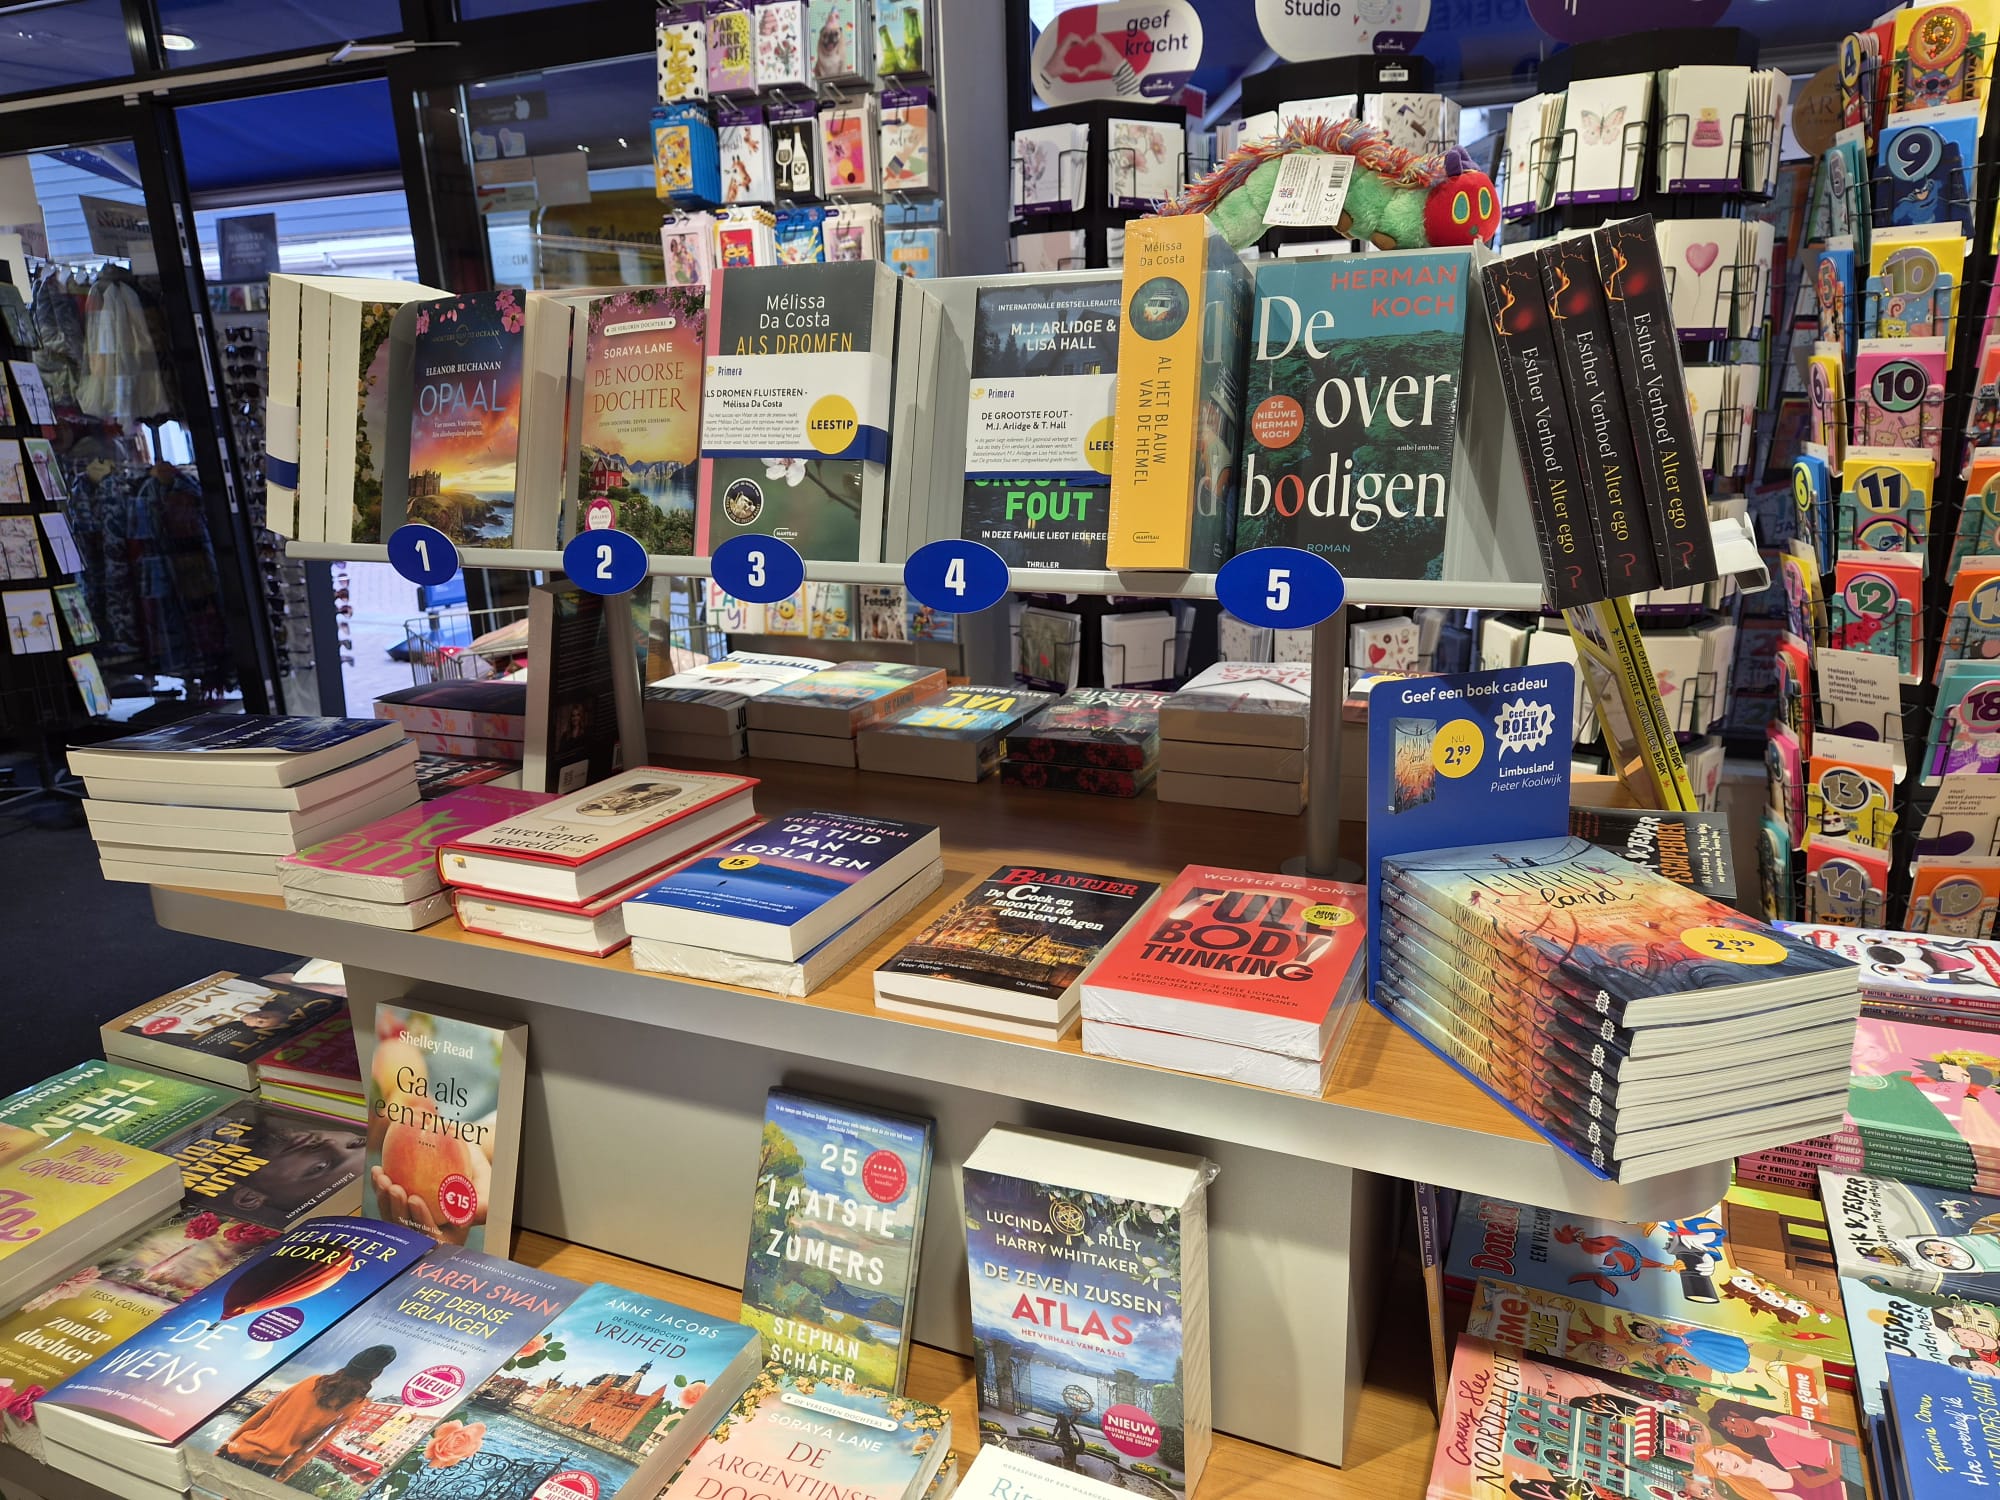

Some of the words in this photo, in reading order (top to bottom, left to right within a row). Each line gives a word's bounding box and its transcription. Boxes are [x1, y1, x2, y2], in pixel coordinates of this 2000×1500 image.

[1284, 0, 1341, 16] Studio
[1127, 11, 1170, 33] geef
[1125, 34, 1189, 55] kracht
[1897, 132, 1933, 177] 9
[1830, 154, 1844, 194] 5
[1144, 241, 1182, 253] Mélissa
[766, 294, 825, 311] Mélissa
[1371, 295, 1455, 318] KOCH
[759, 312, 780, 329] Da
[783, 311, 830, 328] Costa
[603, 344, 641, 359] SORAYA
[644, 342, 672, 355] LANE
[735, 335, 768, 356] ALS
[775, 332, 853, 354] DROMEN
[1026, 338, 1057, 351] LISA
[1059, 337, 1096, 350] HALL
[426, 364, 456, 377] ELEANOR
[457, 361, 501, 374] BUCHANAN
[594, 367, 614, 387] DE
[616, 362, 684, 384] NOORSE
[718, 365, 742, 377] Primera
[1158, 356, 1172, 373] AL
[1521, 345, 1544, 403] Esther
[1139, 379, 1153, 407] VAN
[1156, 380, 1170, 408] HET
[1813, 363, 1824, 403] 6
[1877, 368, 1924, 402] 10
[419, 380, 506, 416] OPAAL
[722, 399, 749, 408] Mélissa
[751, 399, 762, 408] Da
[763, 399, 783, 408] Costa
[1270, 401, 1284, 409] DE
[1315, 373, 1452, 428] over
[811, 419, 853, 430] LEESTIP
[1136, 413, 1150, 433] DE
[1255, 419, 1298, 429] HERMAN
[1257, 409, 1296, 419] NIEUWE
[1152, 413, 1169, 464] BLAUW
[1535, 404, 1563, 473] Verhoef
[1133, 438, 1149, 487] HEMEL
[1243, 452, 1445, 532] bodigen
[1548, 477, 1568, 520] Alter
[1861, 472, 1902, 508] 11
[1005, 492, 1093, 521] FOUT
[981, 531, 990, 539] IN
[992, 531, 1012, 539] DEZE
[1013, 531, 1045, 540] FAMILIE
[1046, 532, 1070, 541] LIEGT
[1072, 532, 1108, 541] IEDEREE
[1307, 543, 1351, 552] ROMAN
[1553, 521, 1575, 554] ego
[415, 540, 431, 572] 1
[596, 544, 612, 579] 2
[748, 551, 766, 587] 3
[1027, 561, 1059, 569] THRILLER
[944, 558, 966, 596] 4
[864, 594, 902, 608] Feestje?
[1850, 580, 1891, 613] 12
[1401, 688, 1436, 704] Geef
[1438, 689, 1463, 699] een
[1467, 681, 1500, 697] boek
[1503, 677, 1548, 693] cadeau
[1617, 639, 1627, 654] HET
[1653, 751, 1668, 775] BOEK
[1451, 735, 1464, 744] NU
[1508, 732, 1536, 742] cadeau
[1444, 745, 1471, 766] 2,99
[1499, 761, 1554, 778] Limbusland
[1490, 781, 1520, 793] Pieter
[1521, 774, 1562, 790] Koolwijk
[1824, 773, 1866, 806] 13
[493, 825, 600, 845] zwevende
[782, 823, 823, 836] DE
[827, 828, 882, 845] TIJD
[783, 816, 842, 828] KRISTIN
[845, 823, 909, 838] HANNAH
[488, 836, 565, 852] wereld
[789, 835, 845, 853] VAN
[984, 888, 1004, 898] De
[1007, 884, 1052, 904] Cock
[1056, 898, 1074, 906] en
[1203, 872, 1278, 885] WOUTER
[1280, 882, 1303, 890] DE
[1307, 886, 1357, 896] JONG
[1823, 867, 1863, 901] 14
[992, 898, 1037, 911] moord
[1040, 904, 1051, 912] in
[1054, 906, 1073, 916] de
[1540, 887, 1641, 909] land
[1936, 885, 1982, 916] 19
[1000, 907, 1058, 923] donkere
[1059, 916, 1104, 931] dagen
[399, 1030, 441, 1054] Shelley
[443, 1040, 474, 1060] Read
[76, 1095, 158, 1136] LET
[126, 1113, 158, 1130] THE
[1833, 1135, 1859, 1145] PAARD
[820, 1143, 858, 1177] 25
[192, 1155, 270, 1198] MIJN
[332, 1172, 355, 1188] Edino
[316, 1187, 331, 1199] van
[1842, 1177, 1870, 1220] JESPER
[285, 1197, 316, 1219] Dorsten
[767, 1179, 897, 1239] LAATSTE
[986, 1210, 1054, 1236] LUCINDA
[1098, 1233, 1142, 1254] RILEY
[1471, 1201, 1521, 1276] Donald
[1848, 1233, 1885, 1258] Rik
[766, 1228, 885, 1286] ZOMERS
[996, 1233, 1046, 1256] HARRY
[1050, 1246, 1139, 1275] WHITTAKER
[410, 1262, 482, 1295] KAREN
[486, 1284, 560, 1317] SWAN
[984, 1262, 1009, 1281] DE
[1013, 1270, 1079, 1296] ZEVEN
[1084, 1284, 1162, 1316] ZUSSEN
[88, 1308, 113, 1323] De
[91, 1290, 114, 1305] TESSA
[115, 1299, 155, 1317] COLLINS
[412, 1286, 447, 1307] HET
[444, 1294, 514, 1327] DEENSE
[395, 1298, 499, 1340] VERLANGEN
[605, 1297, 653, 1320] ANNE
[654, 1313, 720, 1340] JACOBS
[612, 1315, 624, 1324] DE
[623, 1317, 690, 1344] SCHEEPSDOCHTER
[1884, 1300, 1913, 1358] JESPER
[772, 1318, 860, 1361] STEPHAN
[1021, 1328, 1038, 1338] HET
[1037, 1332, 1076, 1348] VERHAAL
[1077, 1342, 1094, 1350] VAN
[1095, 1346, 1106, 1354] PA
[1107, 1349, 1126, 1359] SALT
[99, 1348, 218, 1395] WENS
[1794, 1372, 1817, 1404] game
[806, 1401, 843, 1416] VERLOREN
[844, 1410, 883, 1427] DOCHTERS
[1108, 1415, 1156, 1436] NIEUW
[1446, 1408, 1473, 1466] Carry
[1466, 1369, 1490, 1406] Slee
